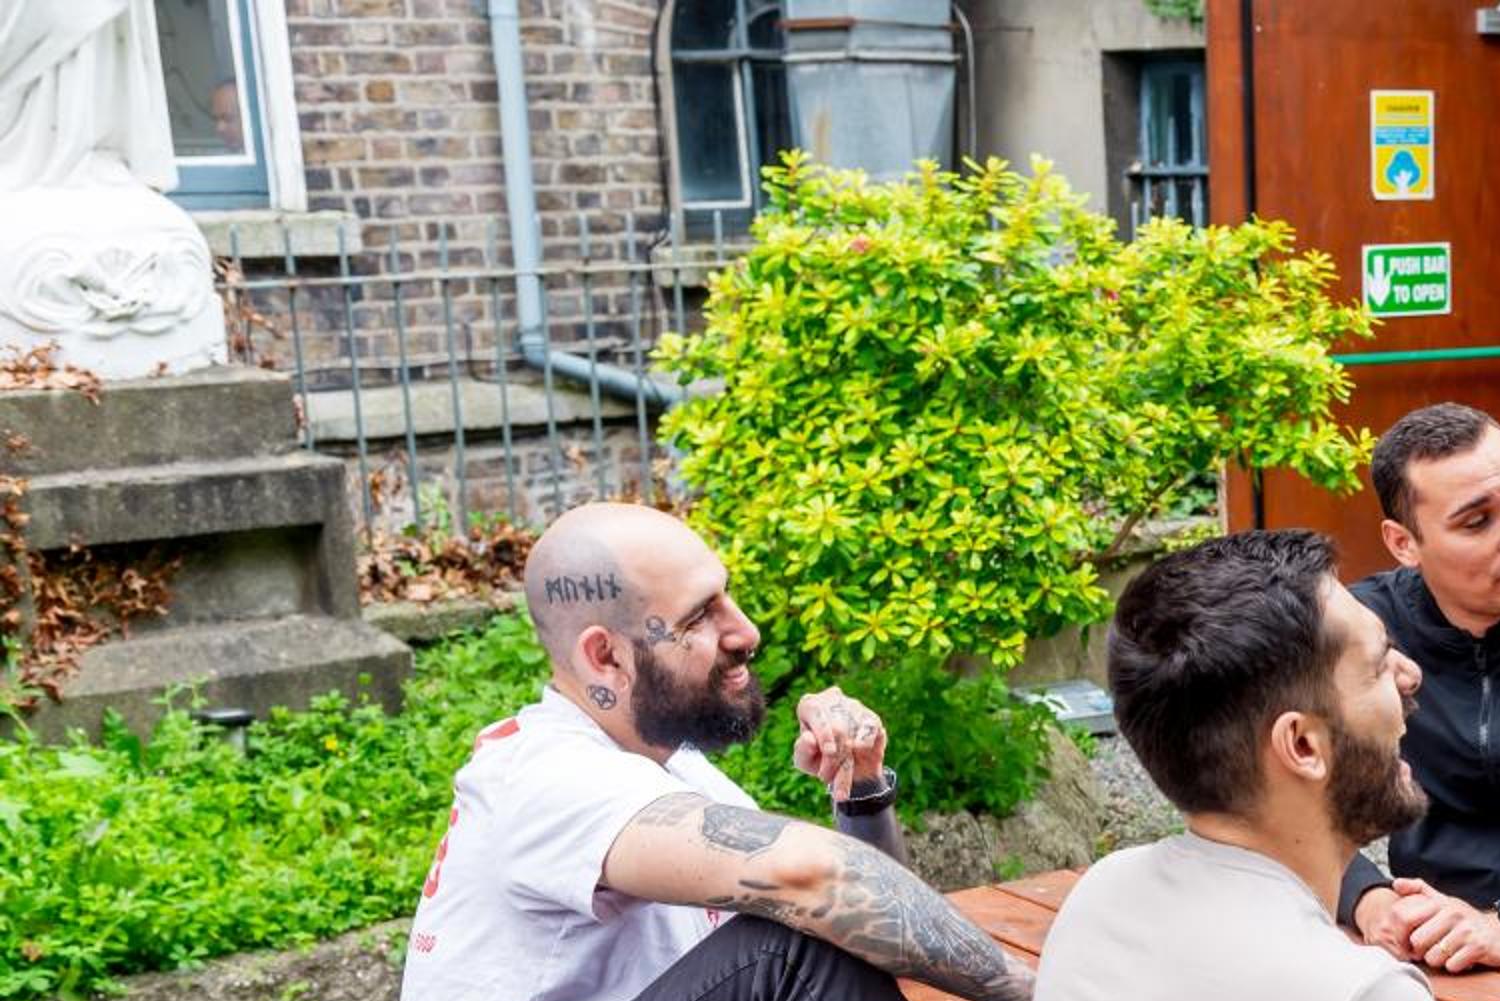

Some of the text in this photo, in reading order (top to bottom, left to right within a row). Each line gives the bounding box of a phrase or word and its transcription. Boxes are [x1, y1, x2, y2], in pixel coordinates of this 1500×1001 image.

[1390, 254, 1446, 275] PUSH BAR
[1394, 283, 1445, 304] TO OPEN
